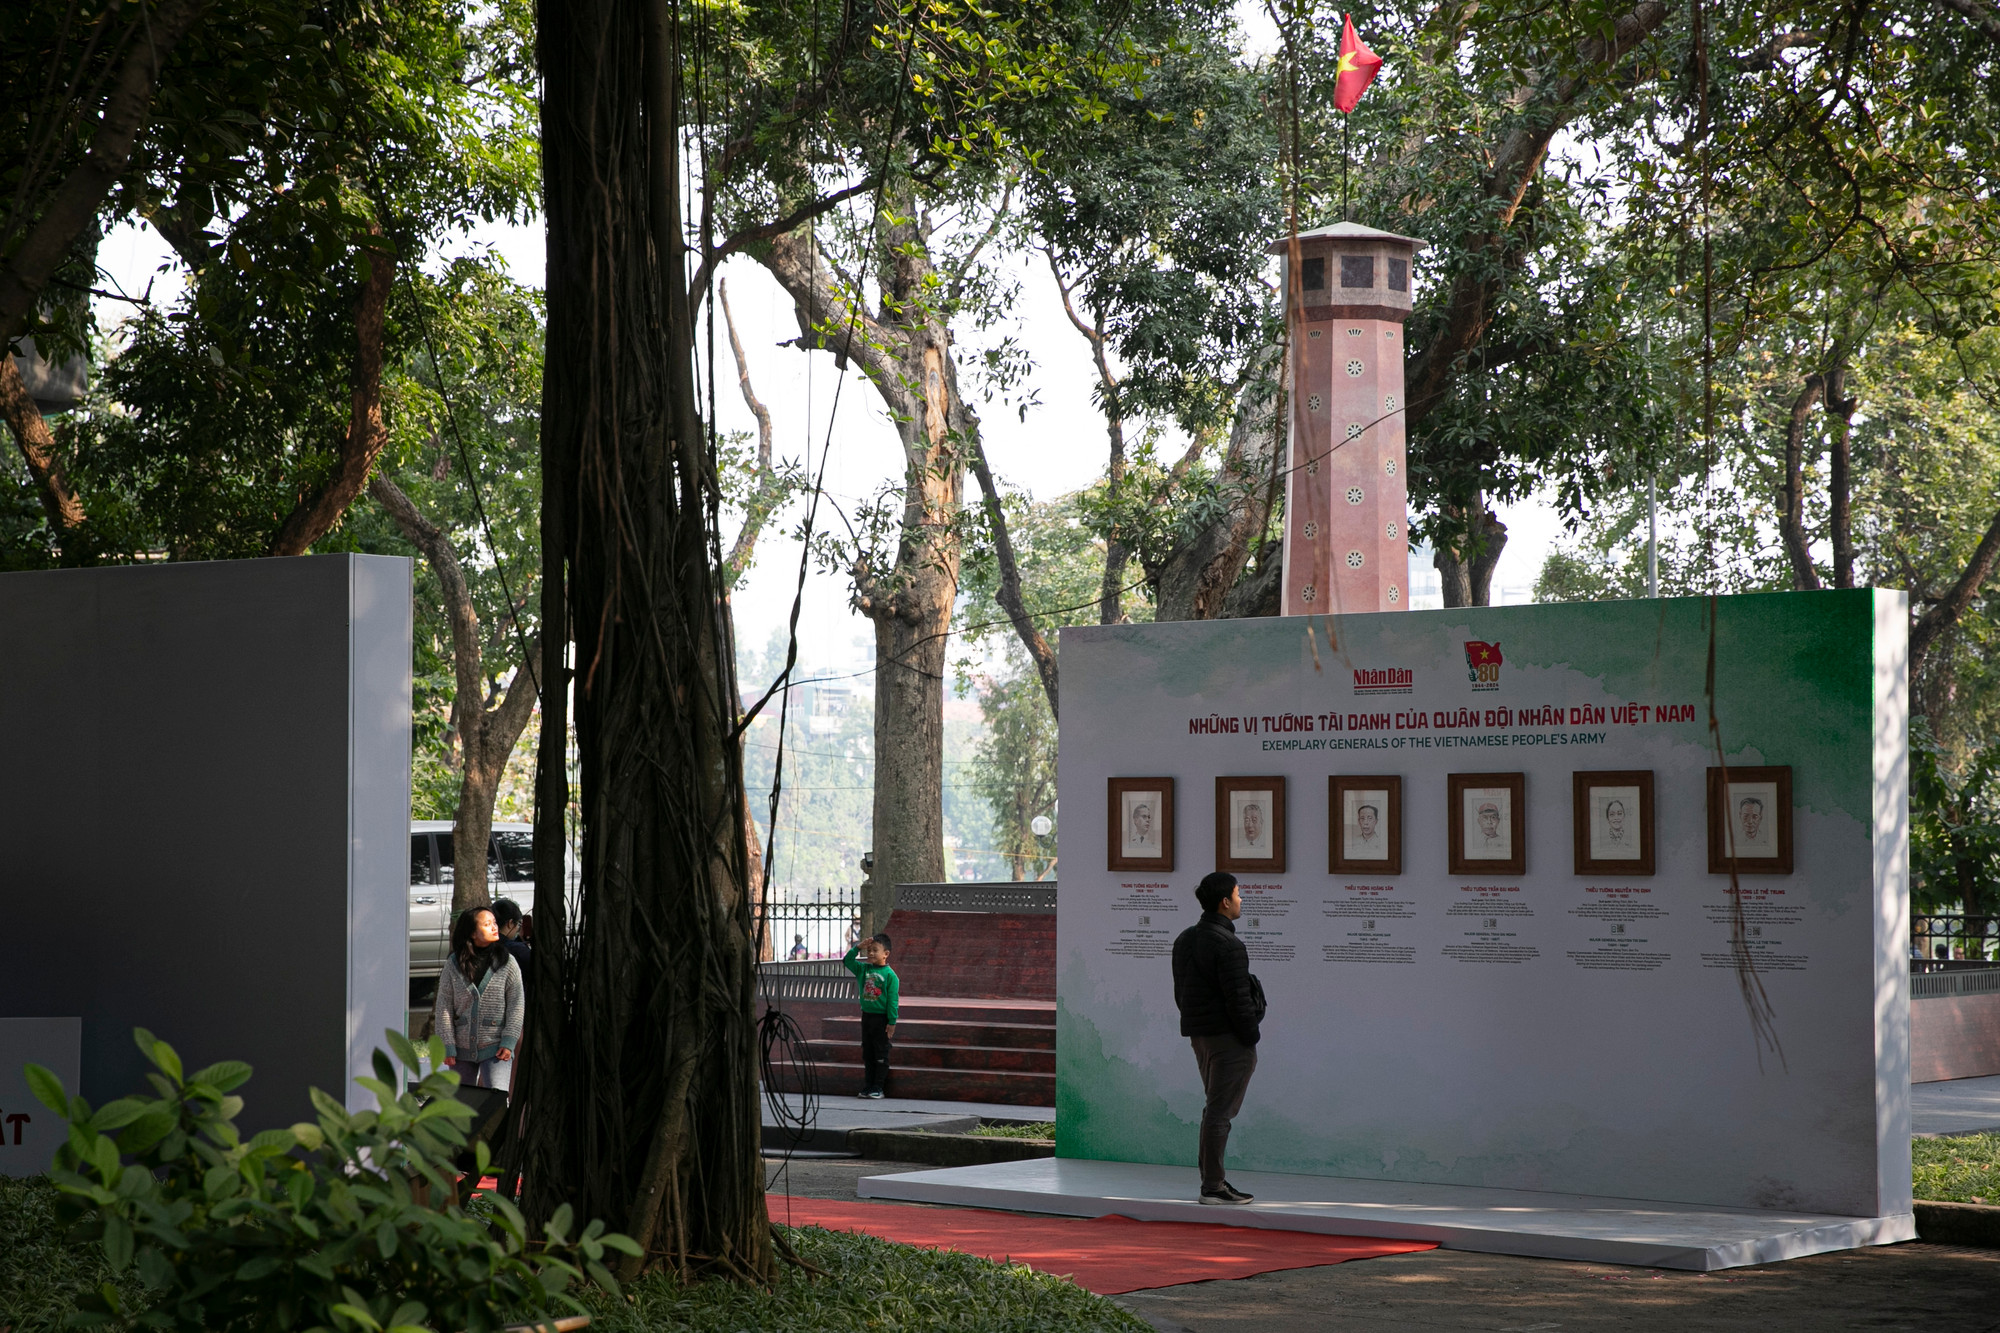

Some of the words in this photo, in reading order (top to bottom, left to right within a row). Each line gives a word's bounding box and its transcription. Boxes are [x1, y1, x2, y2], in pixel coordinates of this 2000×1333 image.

[1354, 668, 1387, 684] Nhân
[1388, 668, 1412, 684] Dân
[1478, 663, 1499, 682] 80
[1189, 713, 1239, 734] NHỮNG
[1244, 716, 1258, 735] VỊ
[1261, 712, 1314, 732] TƯỚNG
[1318, 712, 1343, 731] TÀI
[1348, 713, 1391, 730] DANH
[1396, 708, 1428, 730] CỦA
[1433, 707, 1480, 729] QUÂN
[1484, 706, 1513, 730] ĐỘI
[1518, 704, 1564, 726] NHÂN
[1570, 703, 1605, 725] DÂN
[1610, 702, 1650, 726] VIỆT
[1656, 704, 1695, 722] NAM
[1262, 738, 1327, 751] EXEMPLARY
[1330, 738, 1388, 750] GENERALS
[1391, 737, 1406, 749] OF
[1408, 736, 1431, 748] THE
[1434, 734, 1508, 748] VIETNAMESE
[1570, 732, 1606, 745] ARMY
